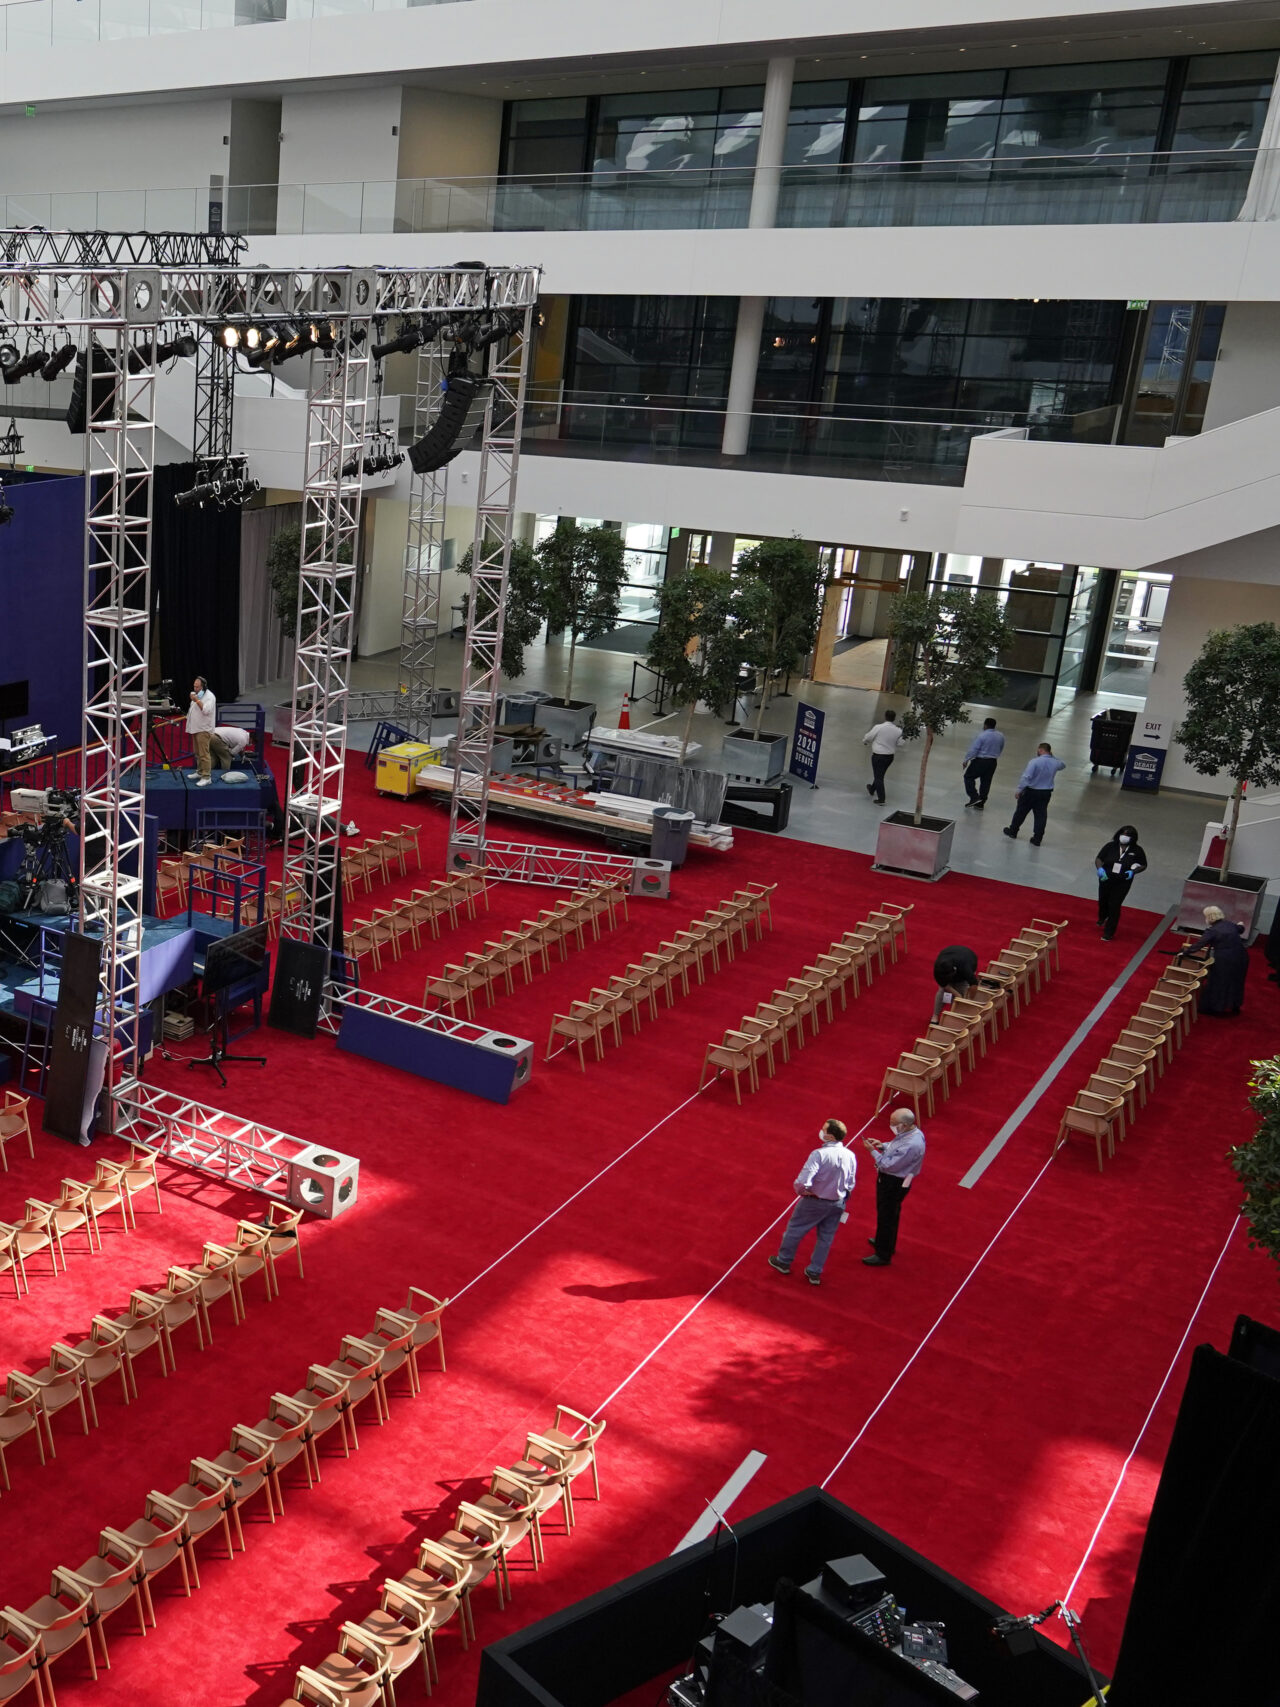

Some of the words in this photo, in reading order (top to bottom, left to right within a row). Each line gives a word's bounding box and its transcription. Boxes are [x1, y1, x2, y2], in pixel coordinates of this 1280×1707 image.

[1145, 722, 1162, 731] EXIT
[797, 734, 817, 753] 2020
[795, 752, 814, 768] DEBATE
[1134, 761, 1157, 770] DEBATE
